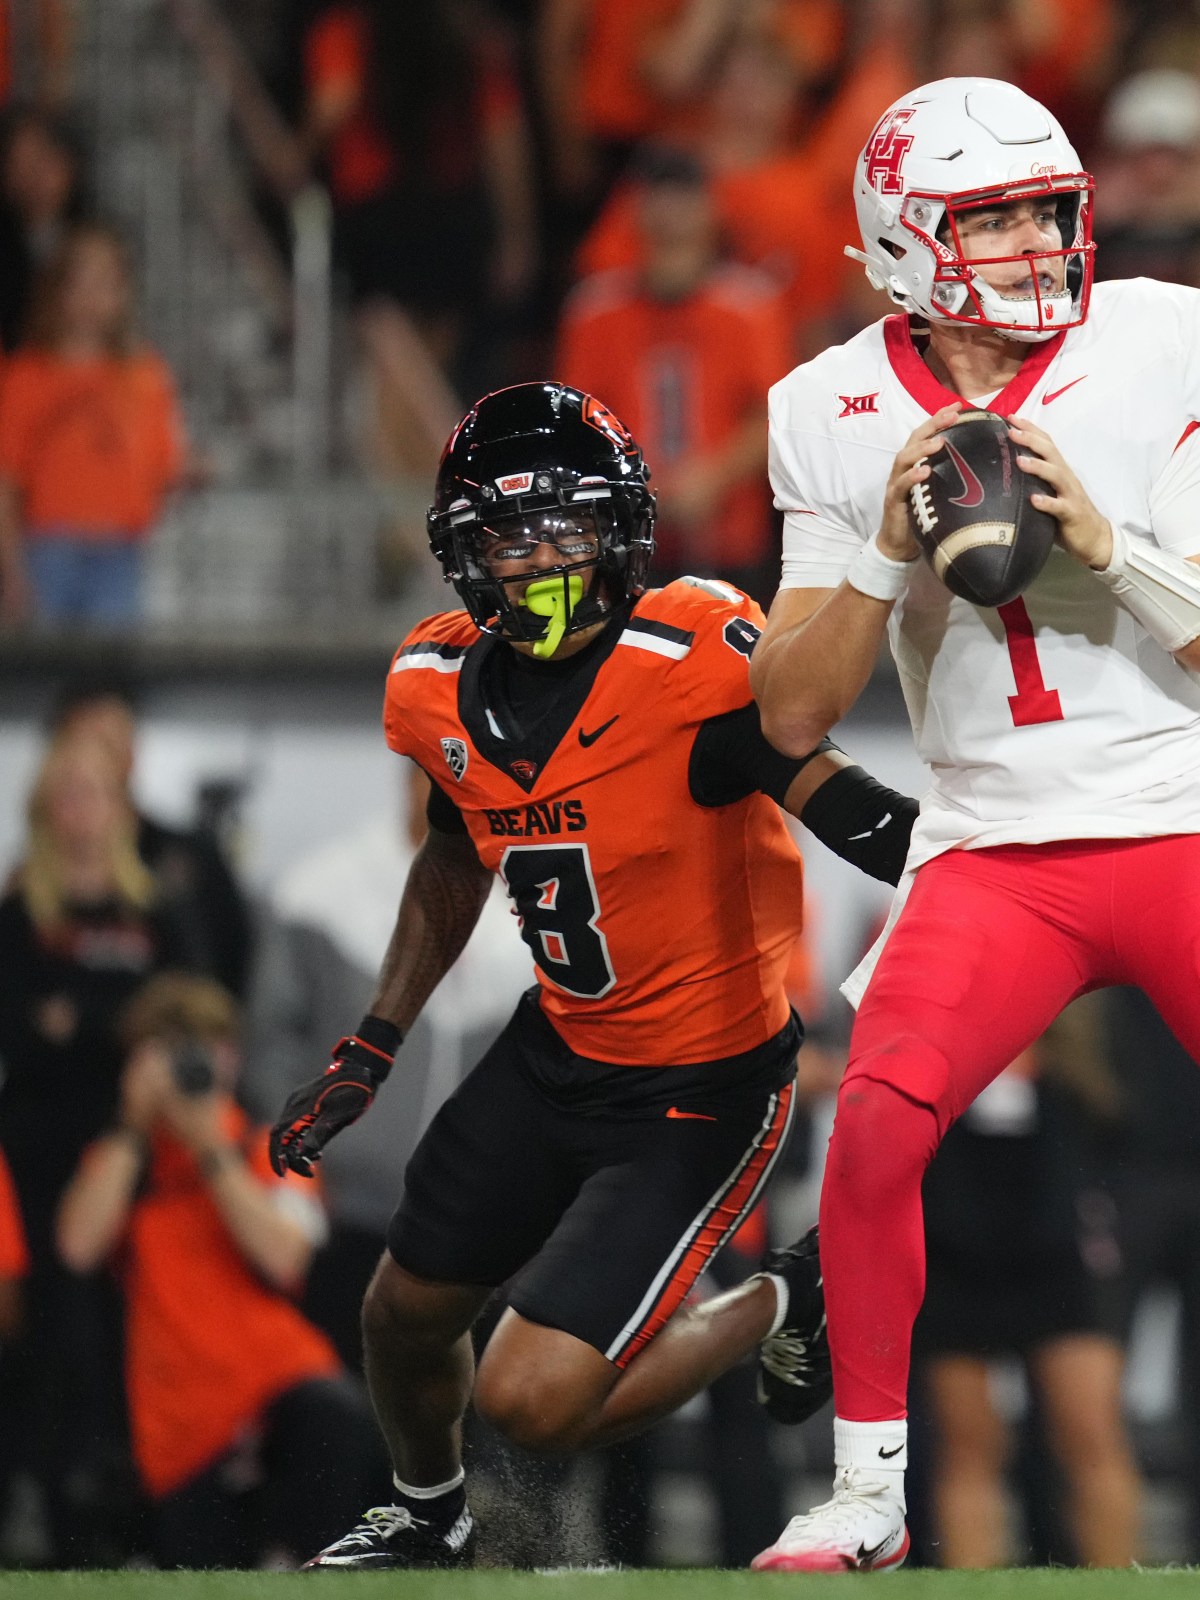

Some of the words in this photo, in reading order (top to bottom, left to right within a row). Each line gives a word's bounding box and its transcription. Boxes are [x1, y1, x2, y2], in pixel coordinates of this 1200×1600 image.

[838, 391, 880, 419] XII
[501, 476, 529, 491] OSU
[996, 594, 1064, 727] 1
[482, 799, 587, 837] BEAVS
[499, 842, 617, 999] 8
